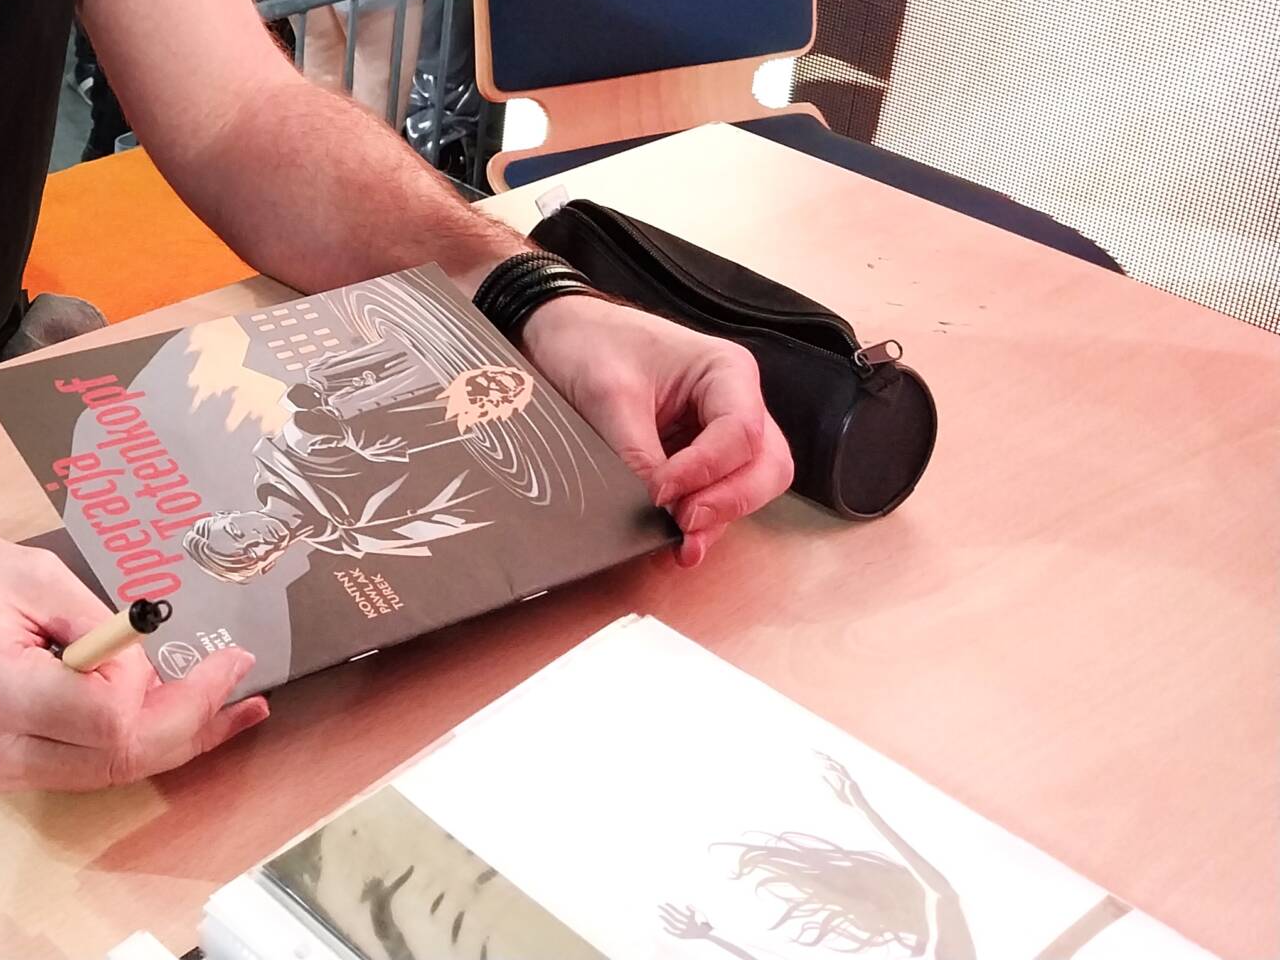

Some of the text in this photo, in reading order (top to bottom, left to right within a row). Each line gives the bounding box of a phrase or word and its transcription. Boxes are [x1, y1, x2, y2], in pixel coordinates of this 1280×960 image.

[53, 374, 213, 541] Totenkopf
[45, 452, 185, 604] Operacja
[333, 571, 378, 619] KONTNY
[348, 567, 392, 614] PAWLAK
[370, 573, 404, 610] TUREK
